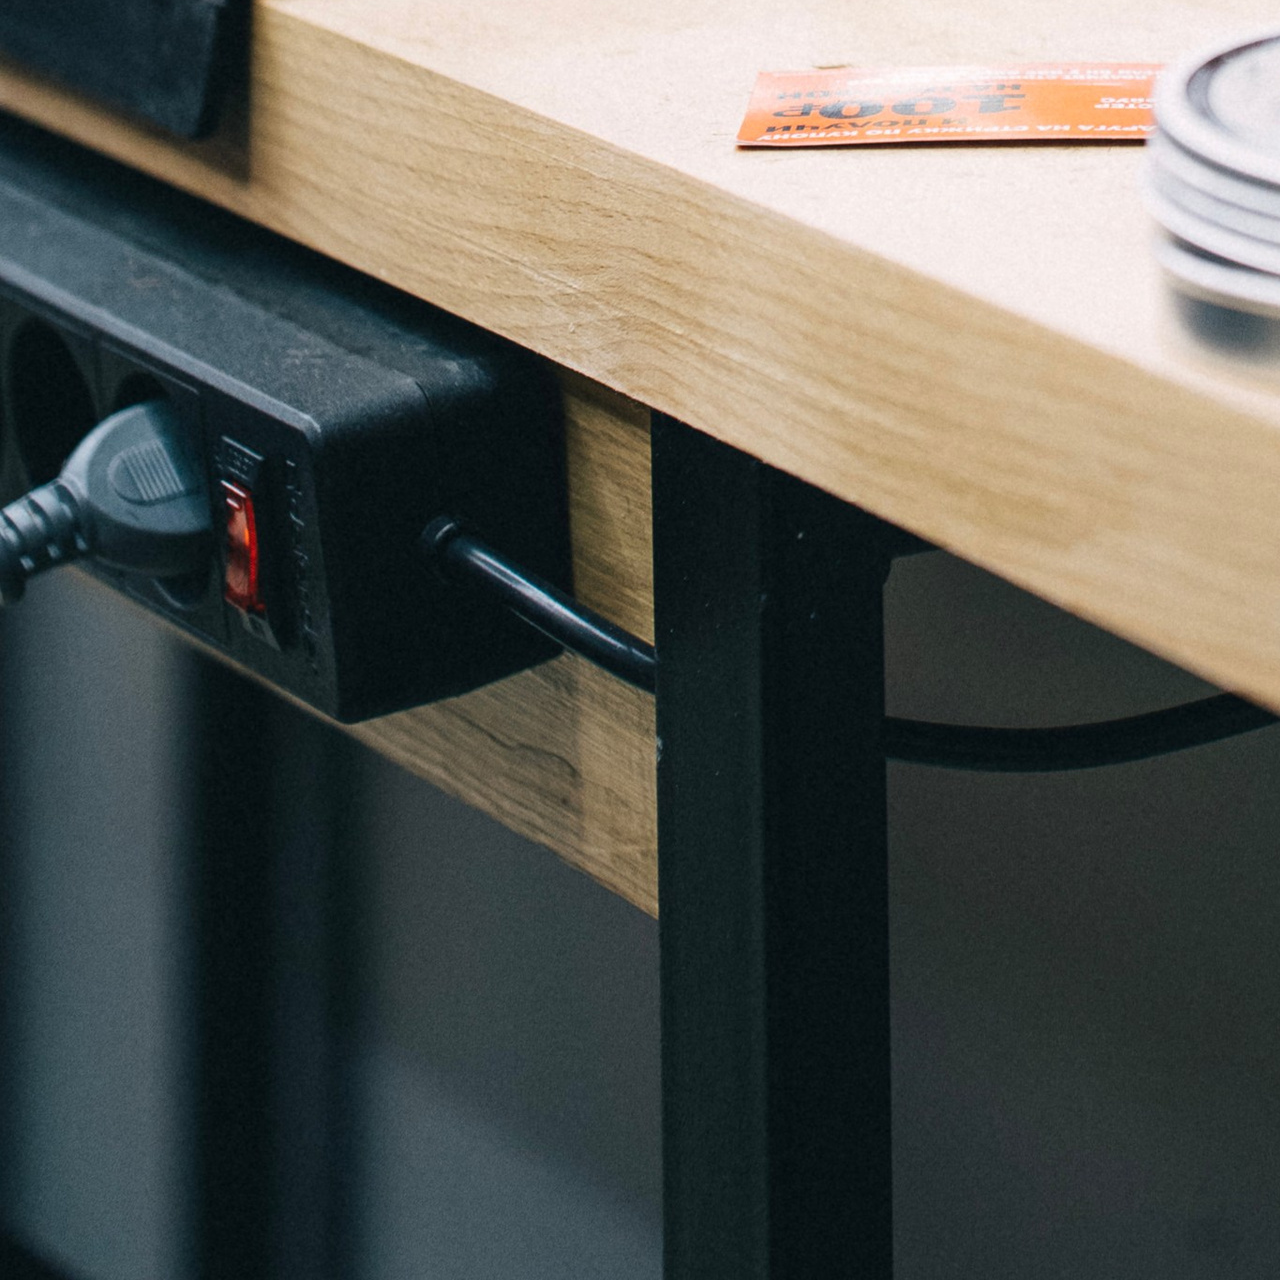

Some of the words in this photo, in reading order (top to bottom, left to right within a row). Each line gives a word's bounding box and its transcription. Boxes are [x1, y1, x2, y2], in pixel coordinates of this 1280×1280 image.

[766, 119, 928, 133] ПОЛУЧИ
[906, 126, 1029, 134] СТРИЖКУ
[756, 130, 859, 141] КУПОНУ
